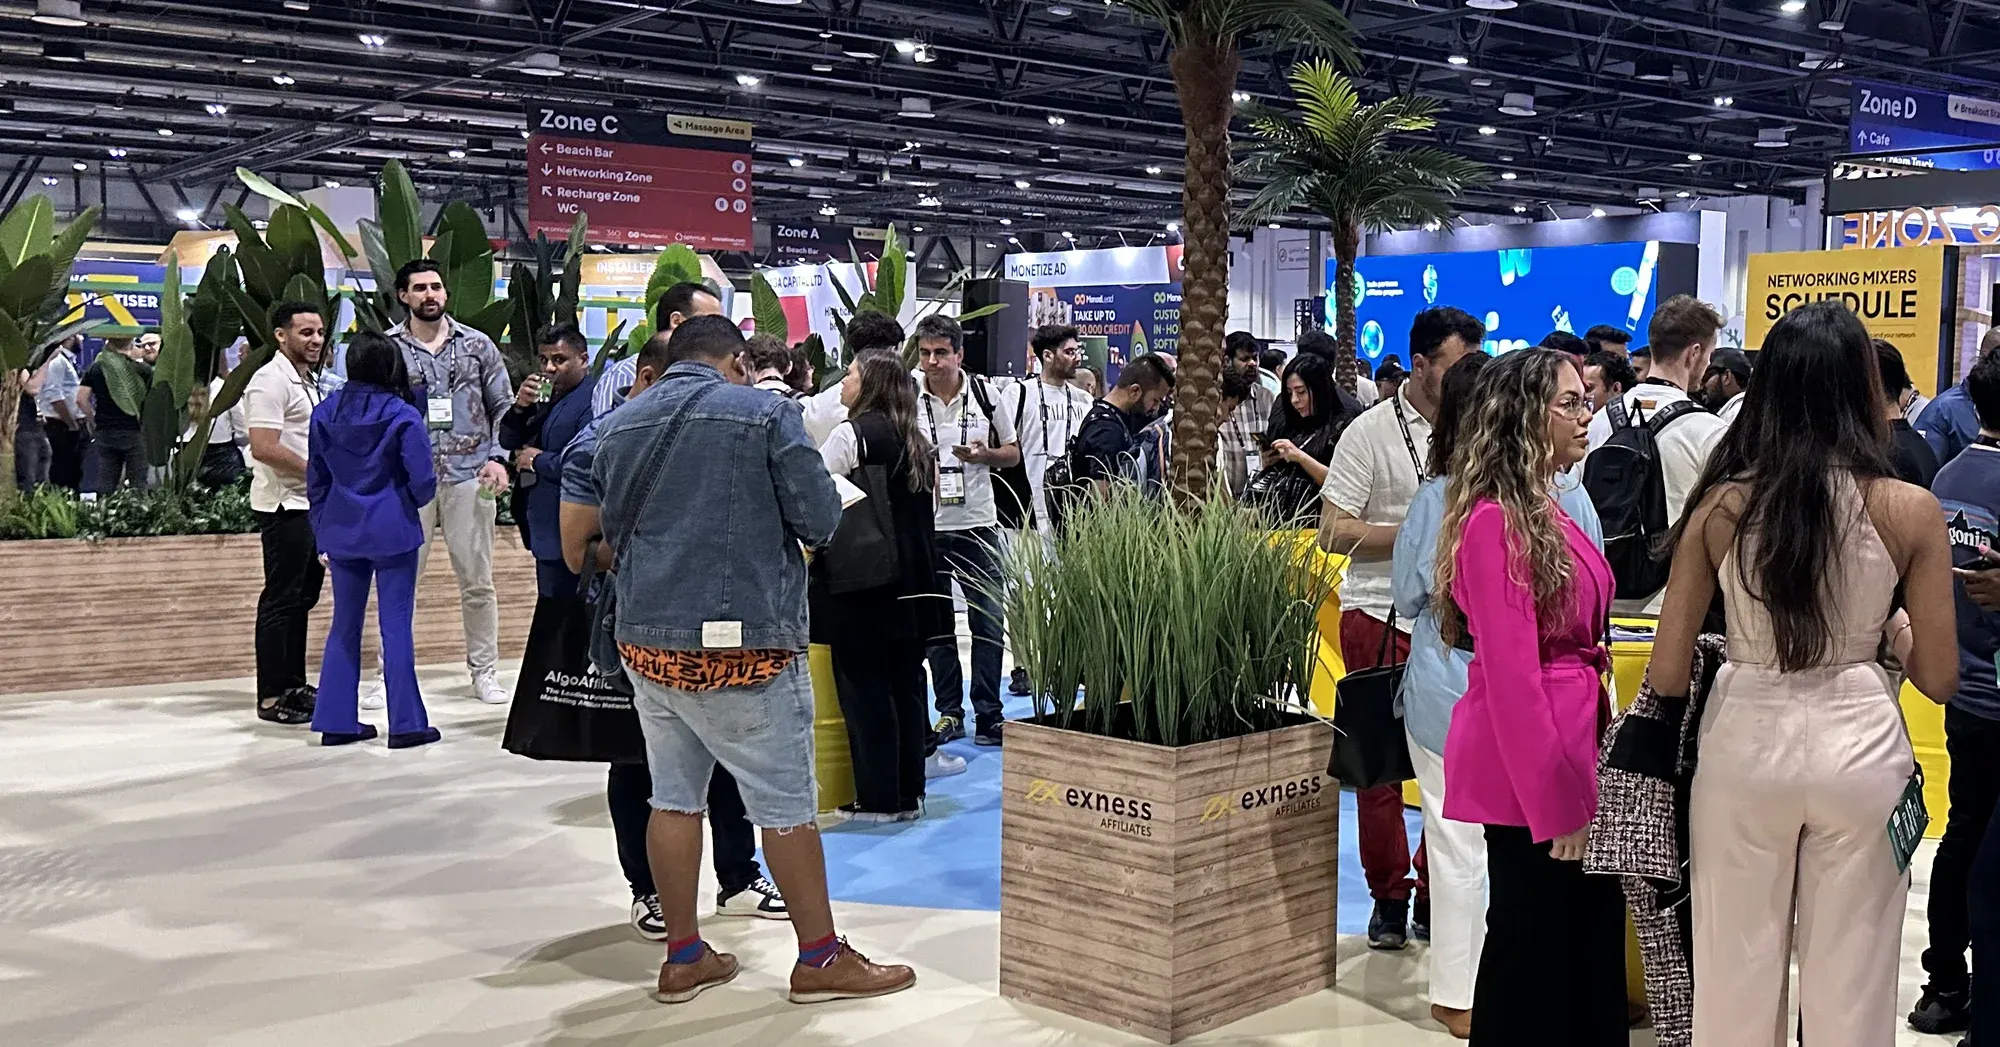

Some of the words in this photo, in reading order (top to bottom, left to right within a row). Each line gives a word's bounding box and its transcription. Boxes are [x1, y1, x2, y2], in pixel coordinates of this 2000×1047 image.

[1860, 89, 1901, 118] Zone
[1904, 96, 1917, 119] D
[1961, 104, 1989, 117] Breakout
[1990, 108, 2000, 118] Sta
[540, 109, 597, 132] Zone
[601, 115, 619, 134] C
[685, 121, 724, 134] Massage
[725, 126, 745, 135] Area
[1869, 131, 1891, 146] Cafe
[556, 144, 593, 157] Beach
[594, 148, 614, 158] Bar
[557, 165, 624, 183] Networking
[625, 171, 653, 183] Zone
[557, 187, 612, 202] Recharge
[613, 191, 641, 203] Zone
[557, 203, 579, 214] WC
[777, 225, 809, 239] Zone
[810, 228, 820, 239] A
[786, 246, 807, 255] Beach
[1011, 263, 1053, 277] MONETIZE
[1054, 262, 1067, 275] AD
[811, 274, 823, 287] LTD
[1767, 271, 1860, 288] NETWORKING
[1863, 269, 1917, 285] MIXERS
[1074, 310, 1093, 321] TAKE
[1094, 310, 1105, 321] UP
[1105, 309, 1116, 321] TO
[1153, 309, 1180, 320] CUSTO
[1104, 324, 1131, 335] CREDIT
[1948, 526, 1991, 548] gonia
[709, 659, 767, 684] LOVE
[545, 686, 560, 695] The
[560, 689, 589, 700] Leading
[540, 693, 577, 706] Marketing
[601, 702, 632, 710] Network
[1241, 775, 1320, 810] exness
[1066, 788, 1152, 821] exness
[1274, 797, 1321, 818] AFFILIATES
[1100, 818, 1152, 838] AFFILIATES
